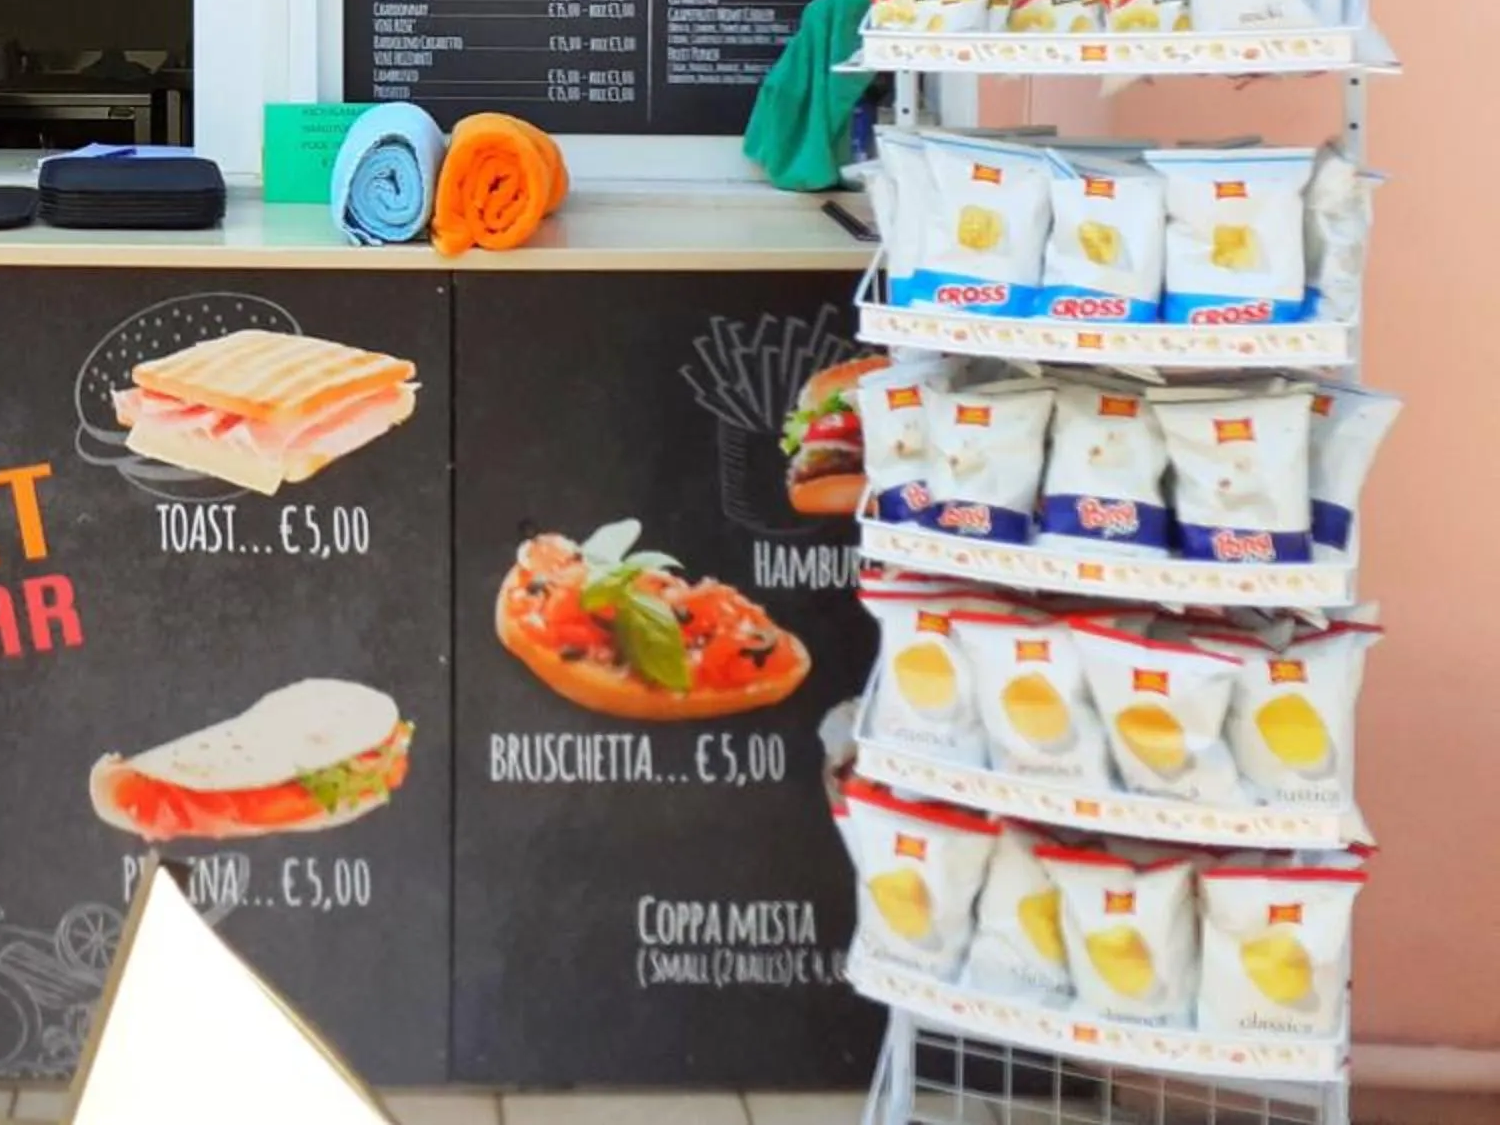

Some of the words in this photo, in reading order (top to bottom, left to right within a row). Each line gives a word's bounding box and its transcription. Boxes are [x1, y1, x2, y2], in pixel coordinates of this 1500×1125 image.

[937, 285, 1006, 305] CROSS
[1053, 298, 1126, 318] CROSS
[1192, 302, 1270, 325] CROSS
[638, 894, 722, 946] COPPA
[726, 900, 817, 946] MISTA
